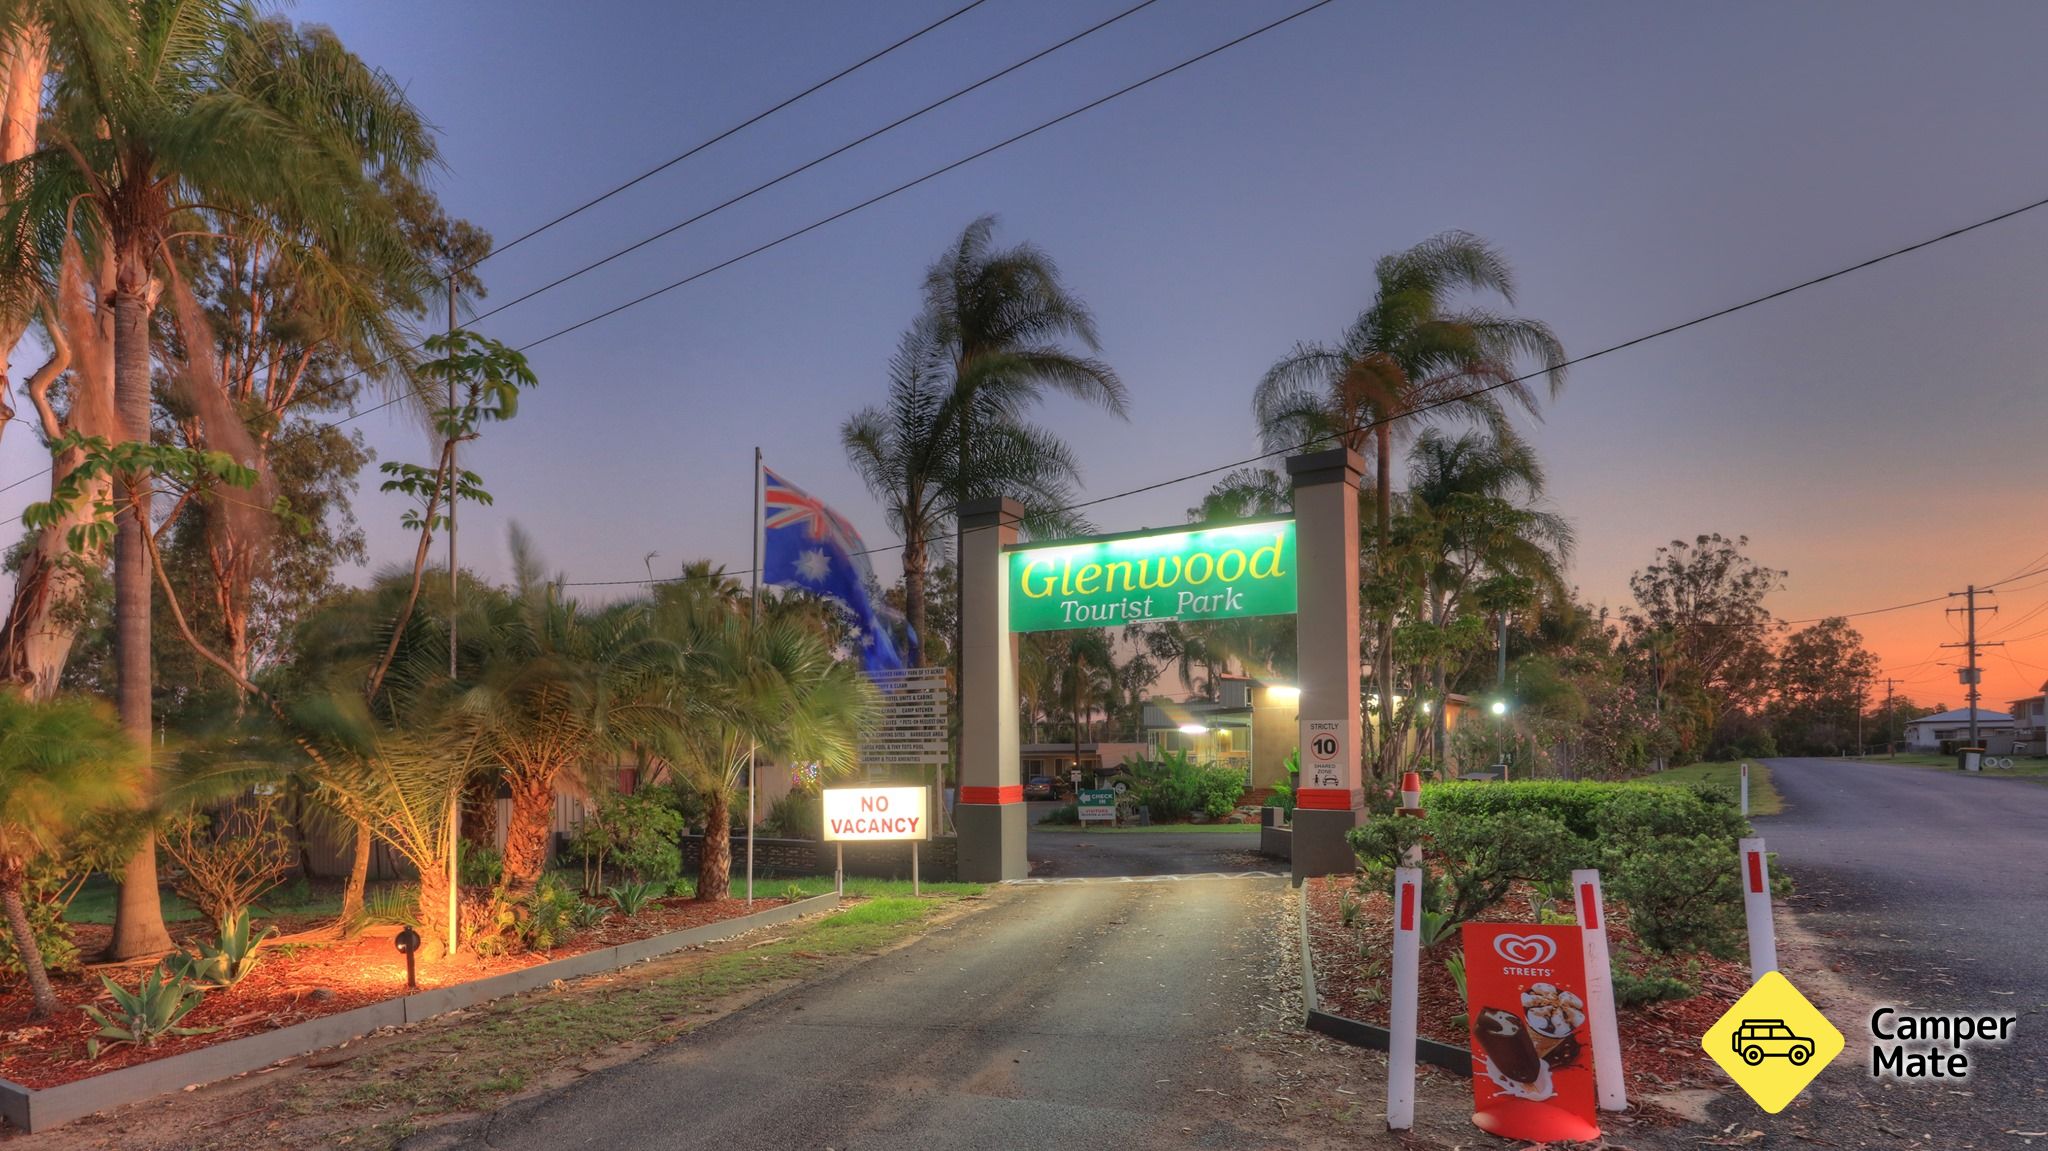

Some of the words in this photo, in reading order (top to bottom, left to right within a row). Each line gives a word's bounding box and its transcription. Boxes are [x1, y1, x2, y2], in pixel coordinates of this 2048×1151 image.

[1021, 531, 1286, 598] Glenwood
[1060, 595, 1153, 623] Tourist
[1176, 587, 1243, 614] Park
[1313, 739, 1336, 754] 10
[861, 796, 888, 812] NO
[831, 817, 920, 833] VACANCY
[1503, 967, 1551, 977] STREETS
